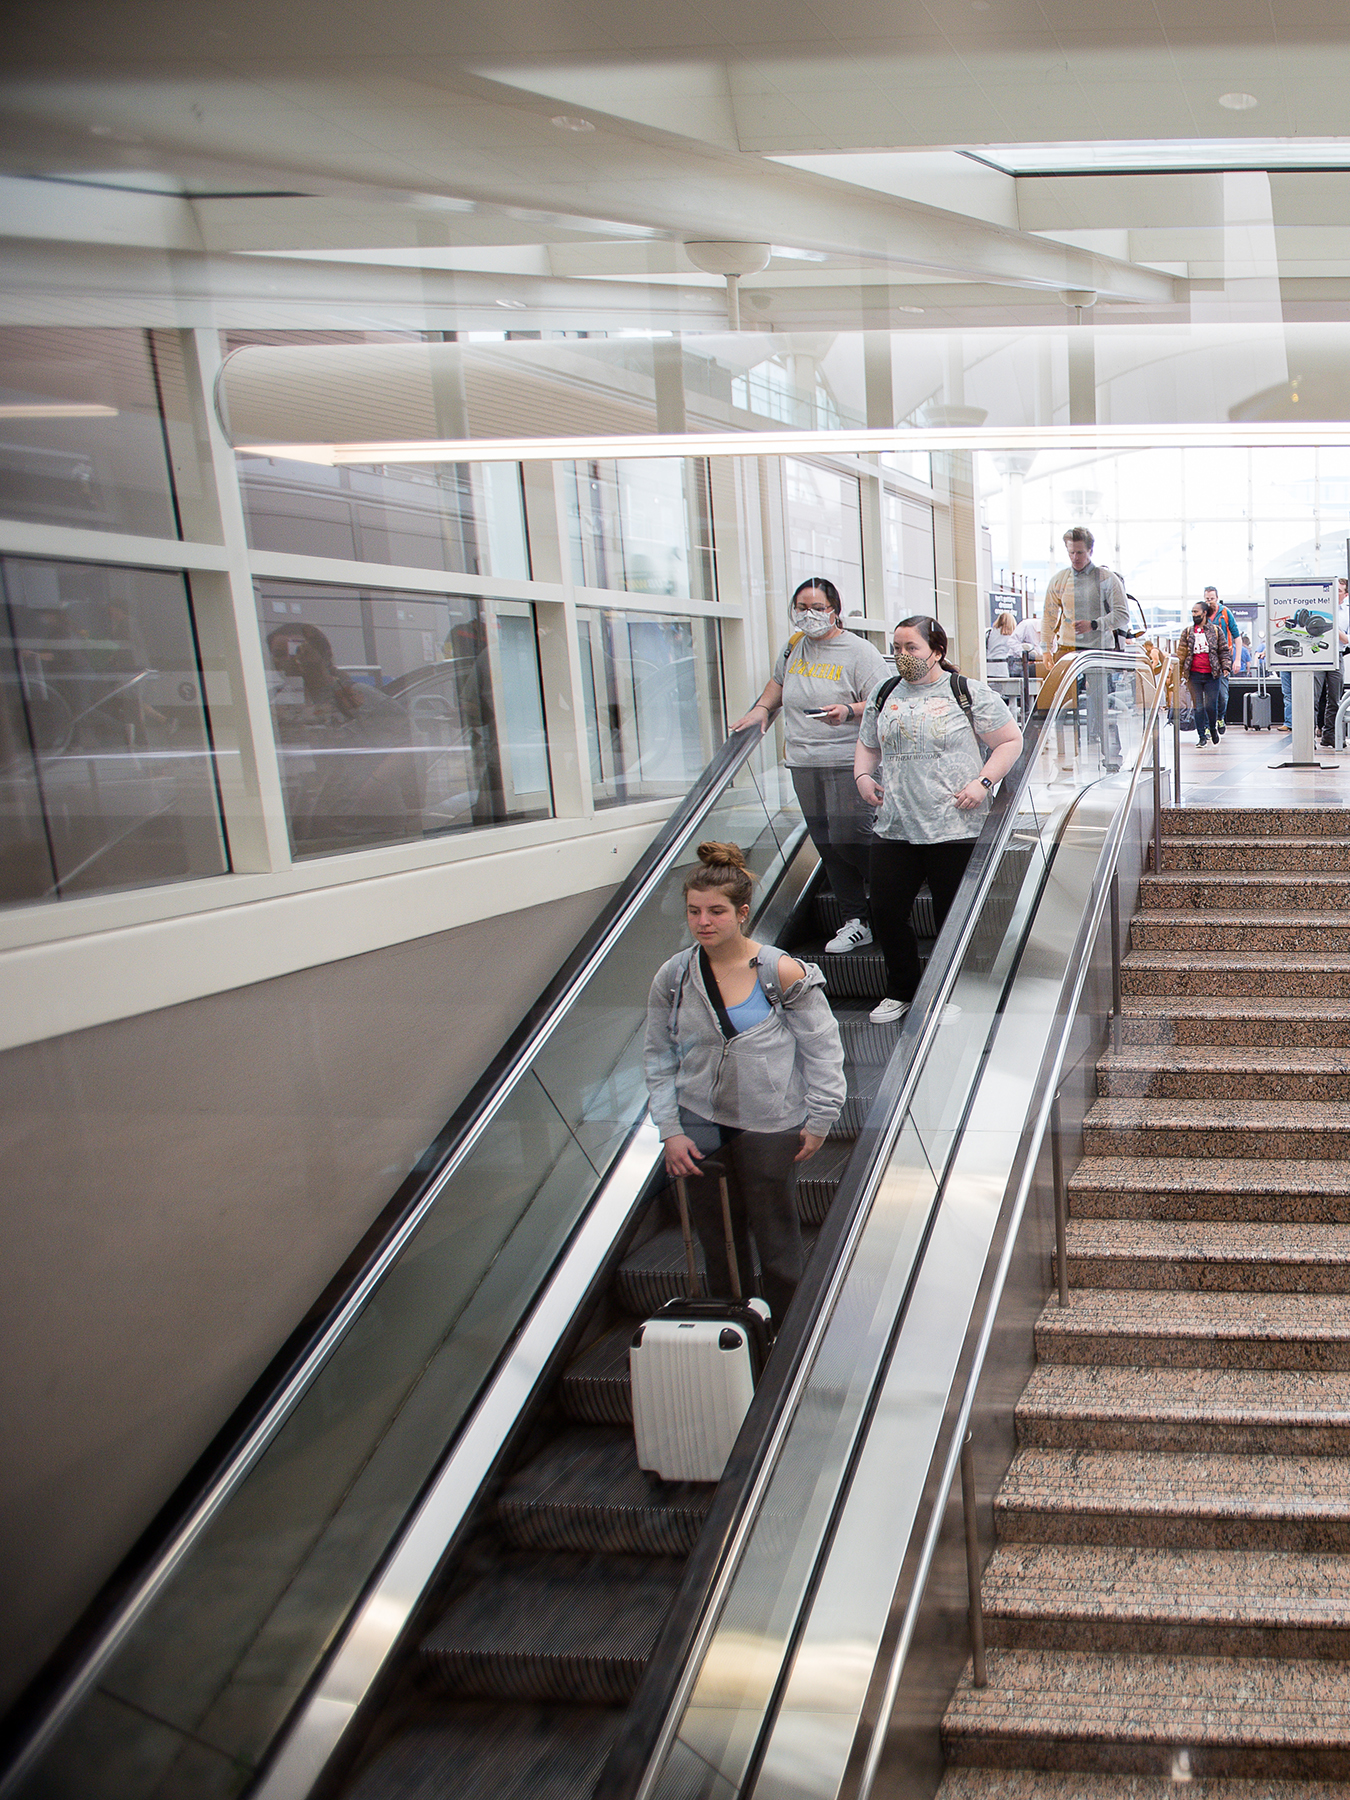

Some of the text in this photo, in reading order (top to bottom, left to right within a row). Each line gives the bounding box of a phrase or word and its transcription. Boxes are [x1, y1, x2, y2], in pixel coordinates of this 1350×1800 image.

[1293, 597, 1316, 606] Forget
[788, 658, 844, 681] APALACHIAN
[894, 754, 913, 762] THEM
[913, 753, 942, 761] WONDER
